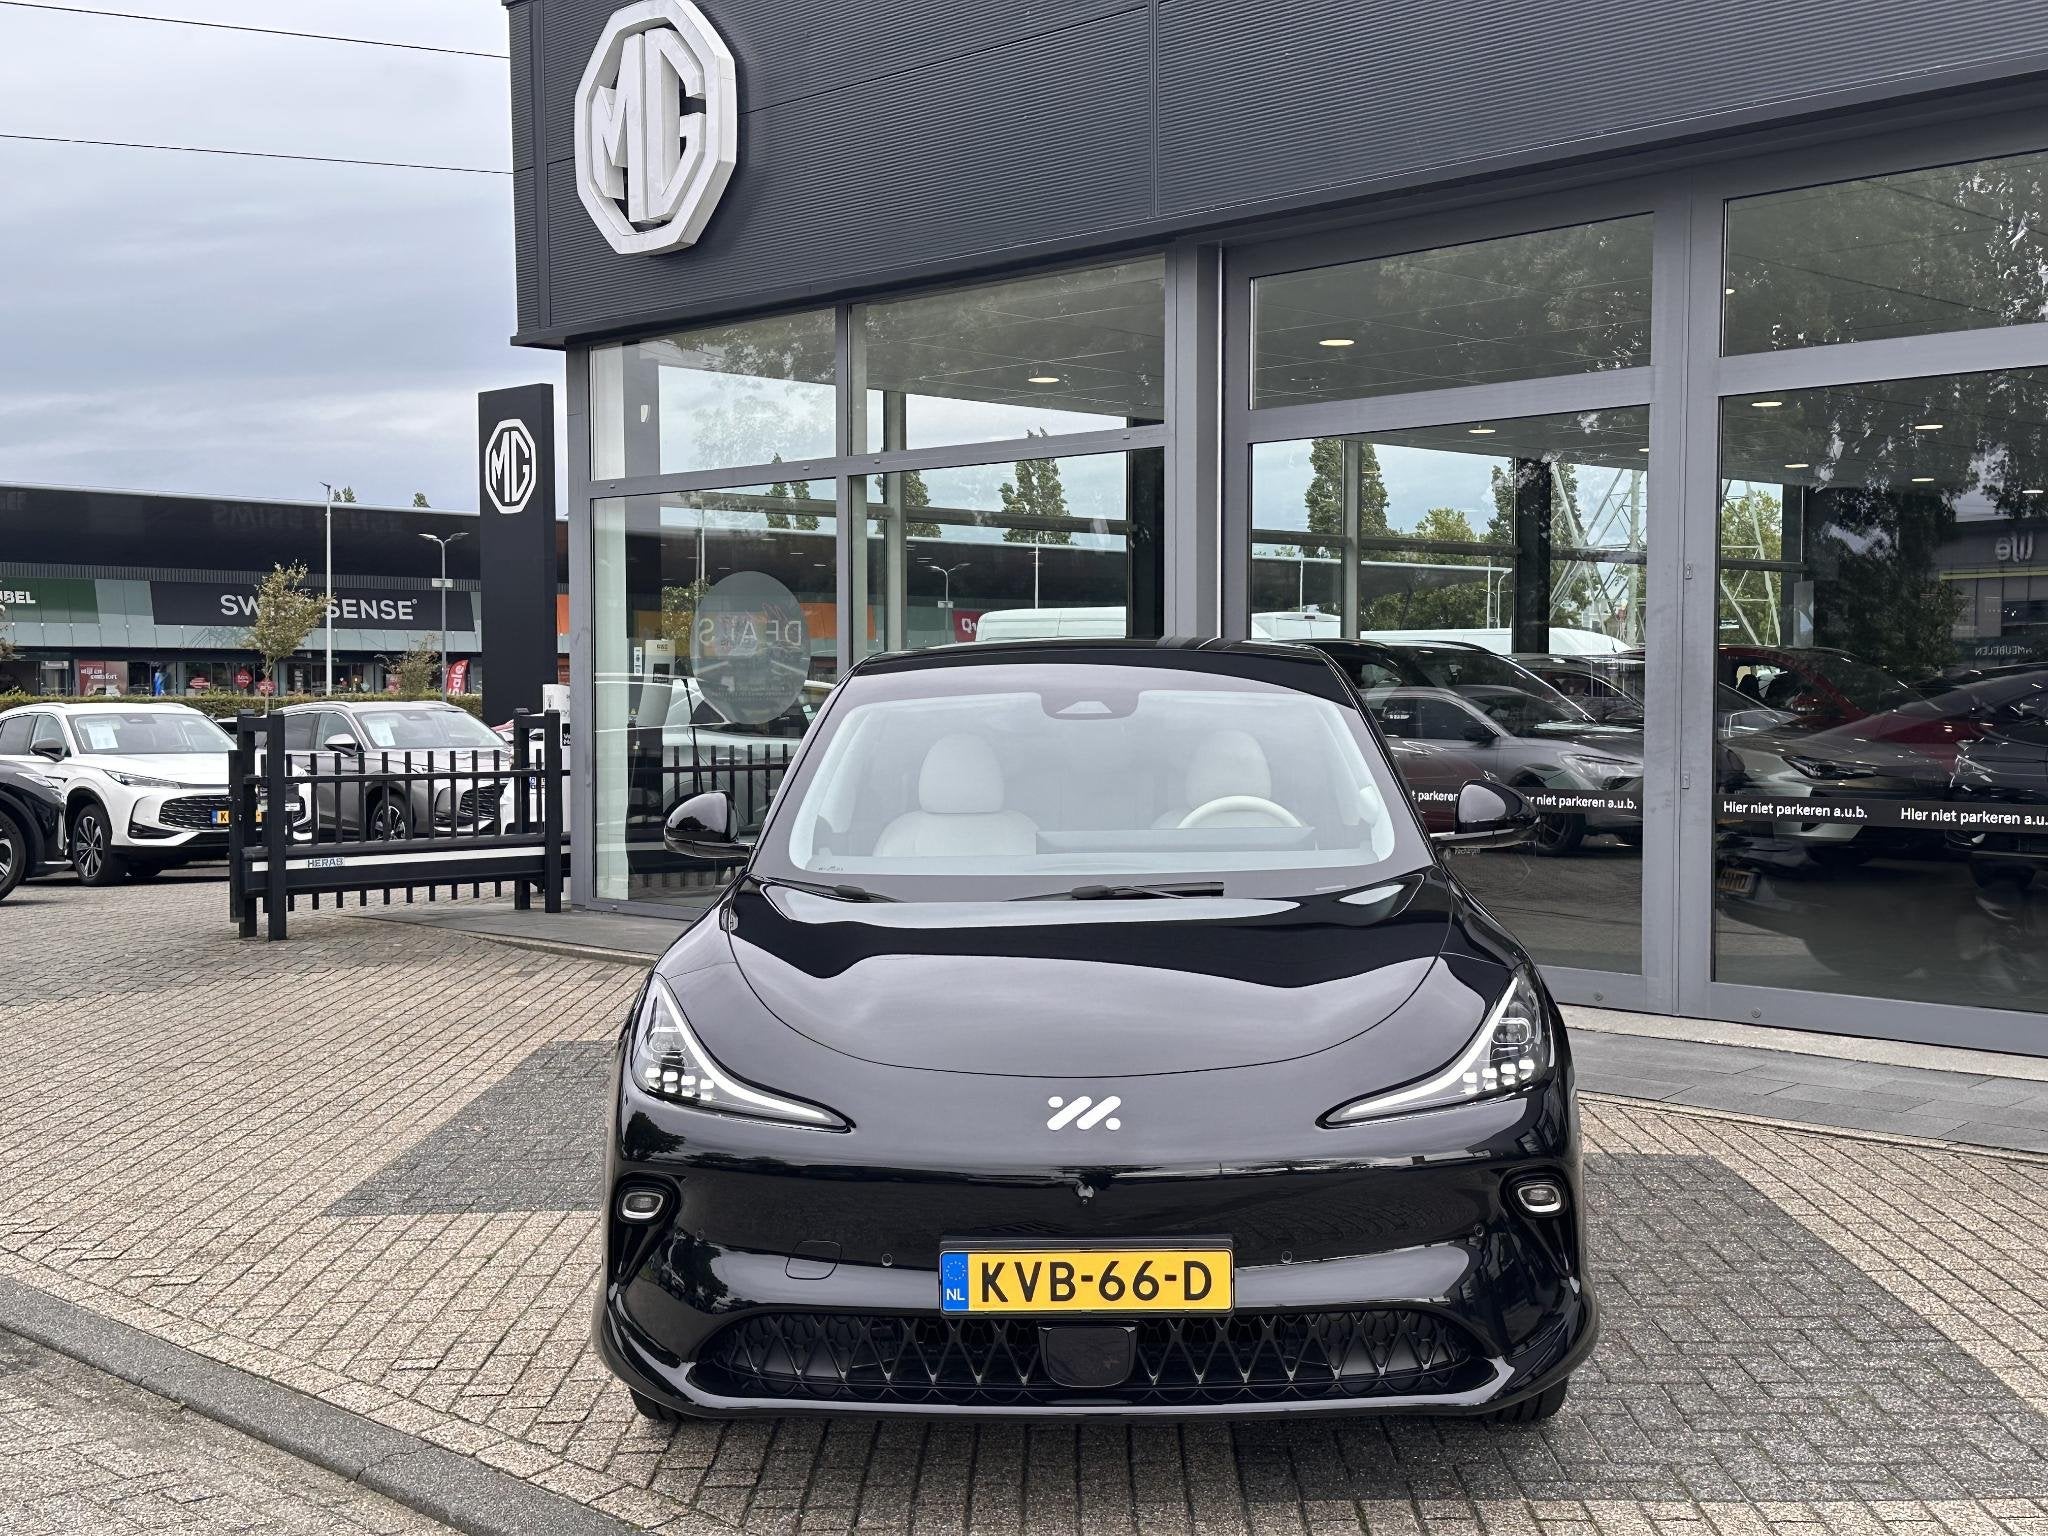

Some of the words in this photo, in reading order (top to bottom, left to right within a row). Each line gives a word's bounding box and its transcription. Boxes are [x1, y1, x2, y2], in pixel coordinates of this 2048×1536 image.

[588, 26, 707, 223] MG
[491, 429, 530, 503] MG
[1537, 793, 1557, 806] niet
[1559, 796, 1605, 809] parkeren
[1607, 798, 1637, 810] a.u.b.
[1723, 801, 1749, 813] Hier
[1750, 802, 1774, 814] niet
[1776, 804, 1831, 818] parkeren
[1833, 806, 1868, 819] a.u.b.
[1900, 807, 1929, 821] Hier
[1931, 809, 1958, 822] niet
[1960, 811, 2021, 826] parkeren
[307, 857, 344, 868] HERAS
[946, 1288, 965, 1301] NL
[980, 1260, 1213, 1303] KVB-66-D
